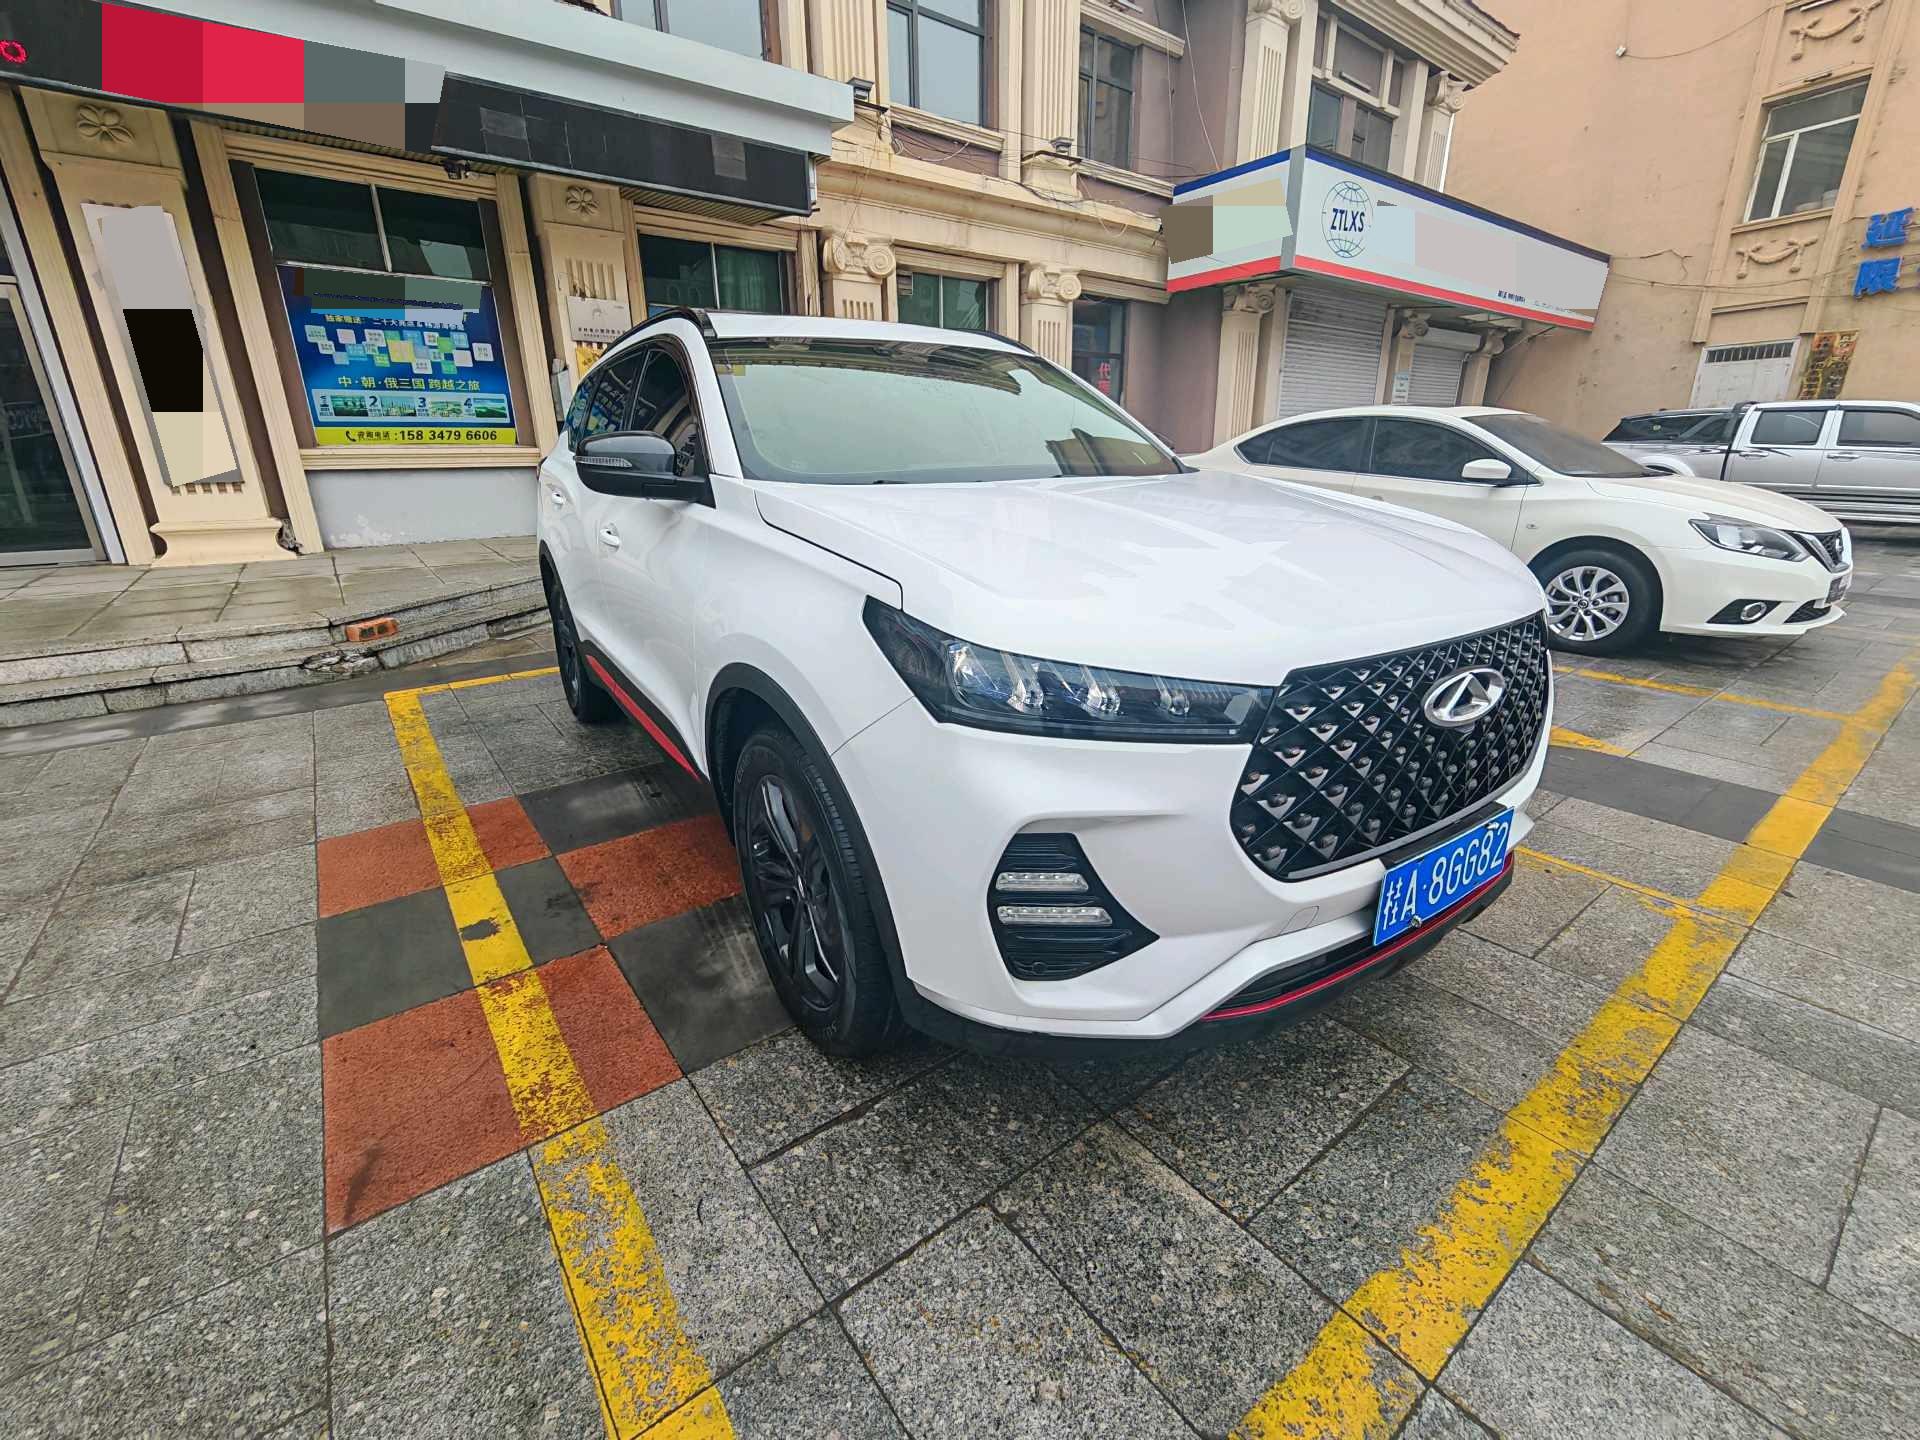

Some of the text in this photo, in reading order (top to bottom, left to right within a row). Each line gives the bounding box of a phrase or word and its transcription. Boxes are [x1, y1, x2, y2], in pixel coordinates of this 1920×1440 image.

[1330, 207, 1365, 233] ZTLXS
[428, 378, 481, 391] 跨越之旅
[428, 430, 461, 441] 3479
[465, 430, 498, 441] 6606
